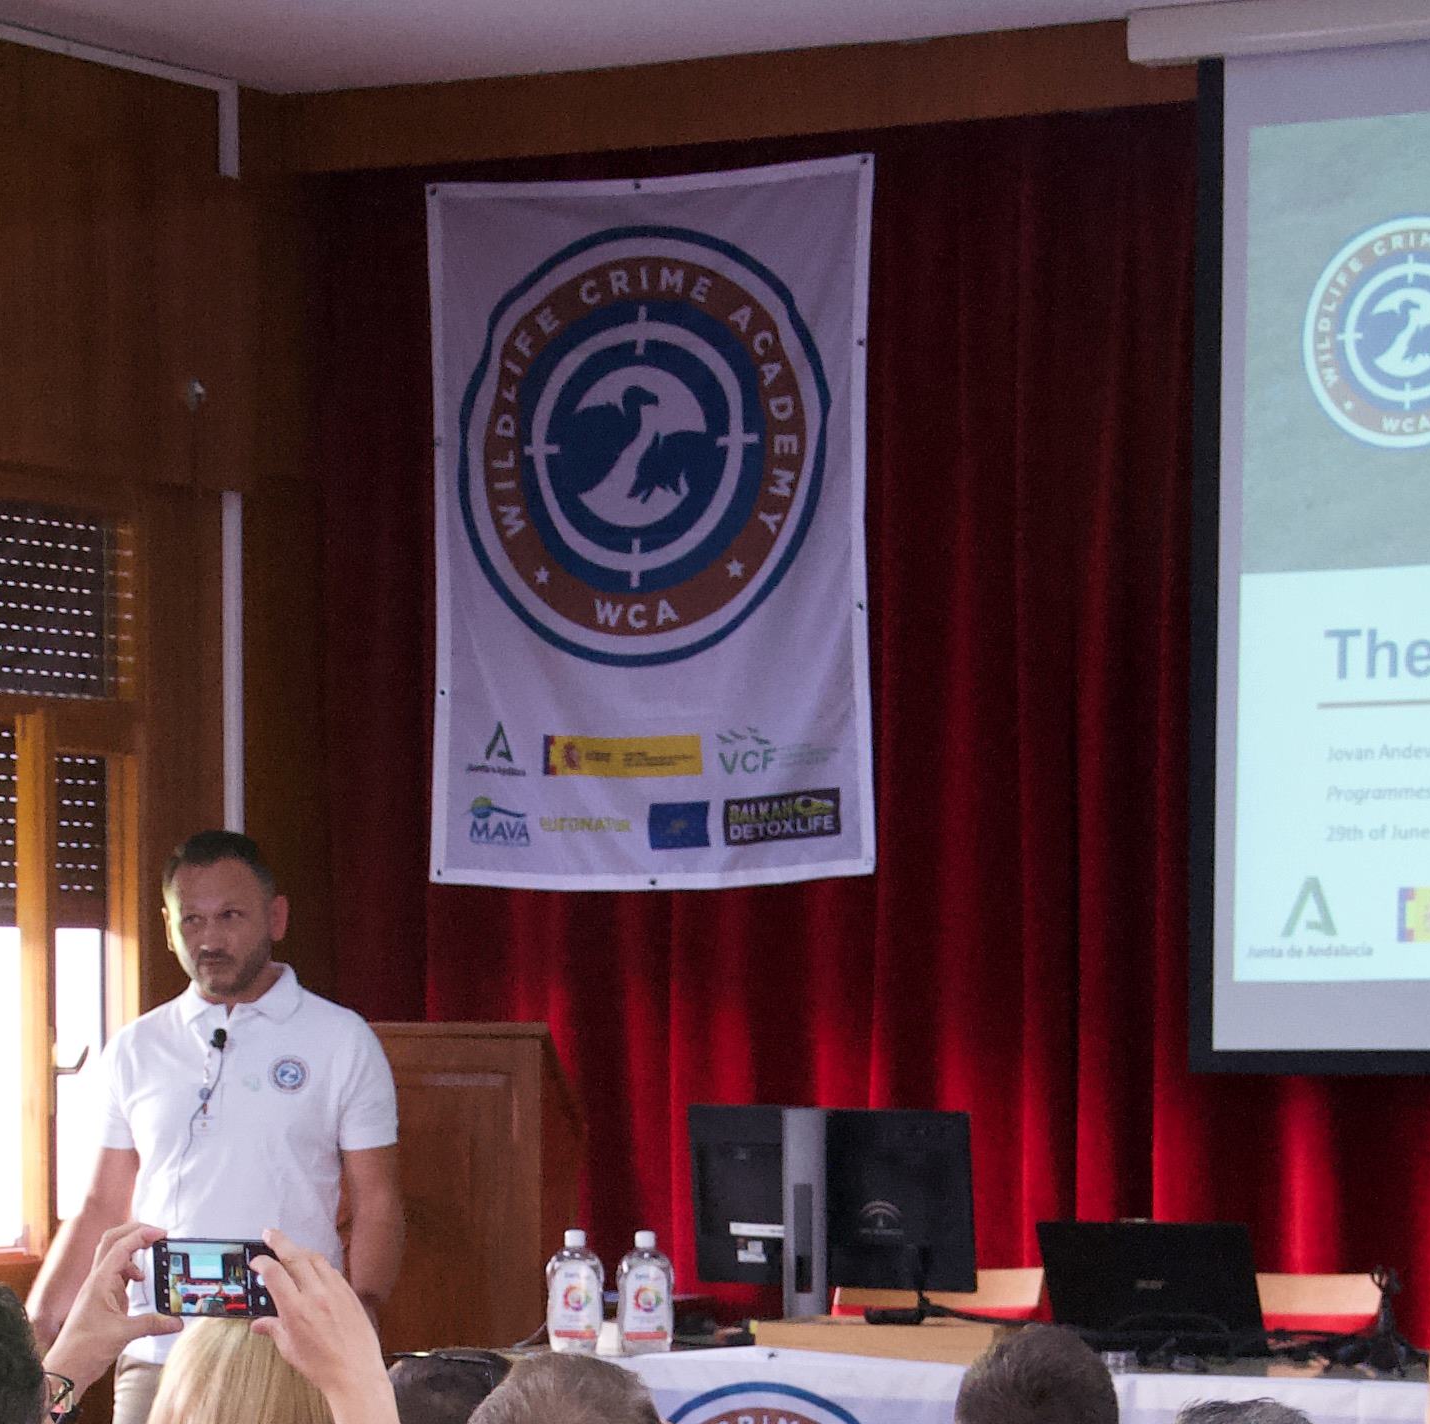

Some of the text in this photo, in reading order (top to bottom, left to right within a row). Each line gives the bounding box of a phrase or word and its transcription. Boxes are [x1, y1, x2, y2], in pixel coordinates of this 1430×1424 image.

[1317, 256, 1364, 387] WILDLIFE
[492, 265, 799, 538] WILDLIFE CRIME ACADEMY
[594, 598, 680, 628] WCA
[718, 747, 777, 775] VCF
[1327, 745, 1375, 763] Jovan
[469, 820, 531, 842] MAVA
[1326, 824, 1364, 842] 29th
[1368, 823, 1387, 841] of
[1391, 823, 1430, 841] June
